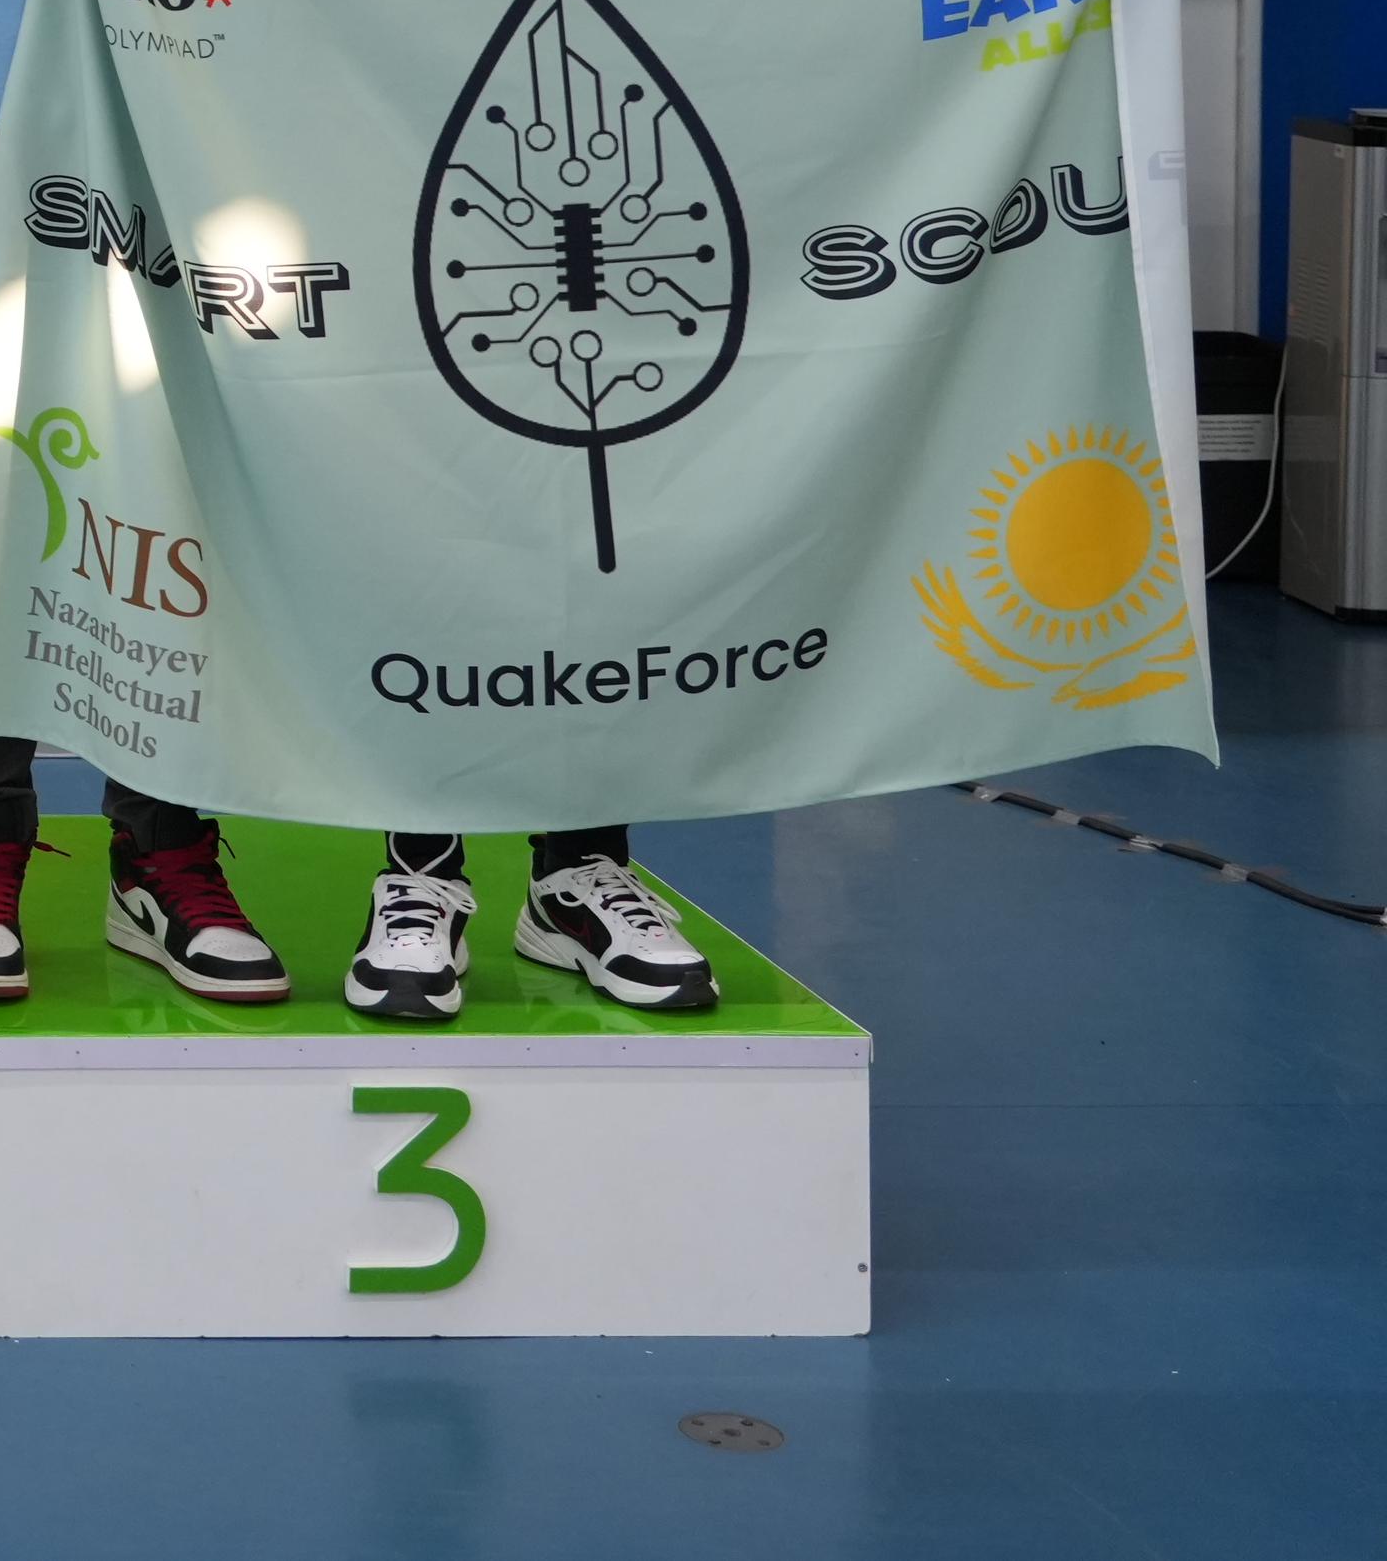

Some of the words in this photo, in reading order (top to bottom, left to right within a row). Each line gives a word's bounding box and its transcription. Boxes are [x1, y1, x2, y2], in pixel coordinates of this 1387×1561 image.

[800, 155, 1129, 301] SCOU
[72, 497, 208, 617] NIS
[24, 630, 202, 723] Intellectual
[27, 586, 209, 677] Nazarbayev
[370, 627, 828, 714] QuakeForce
[53, 682, 158, 759] Schools
[347, 1086, 487, 1295] 3
